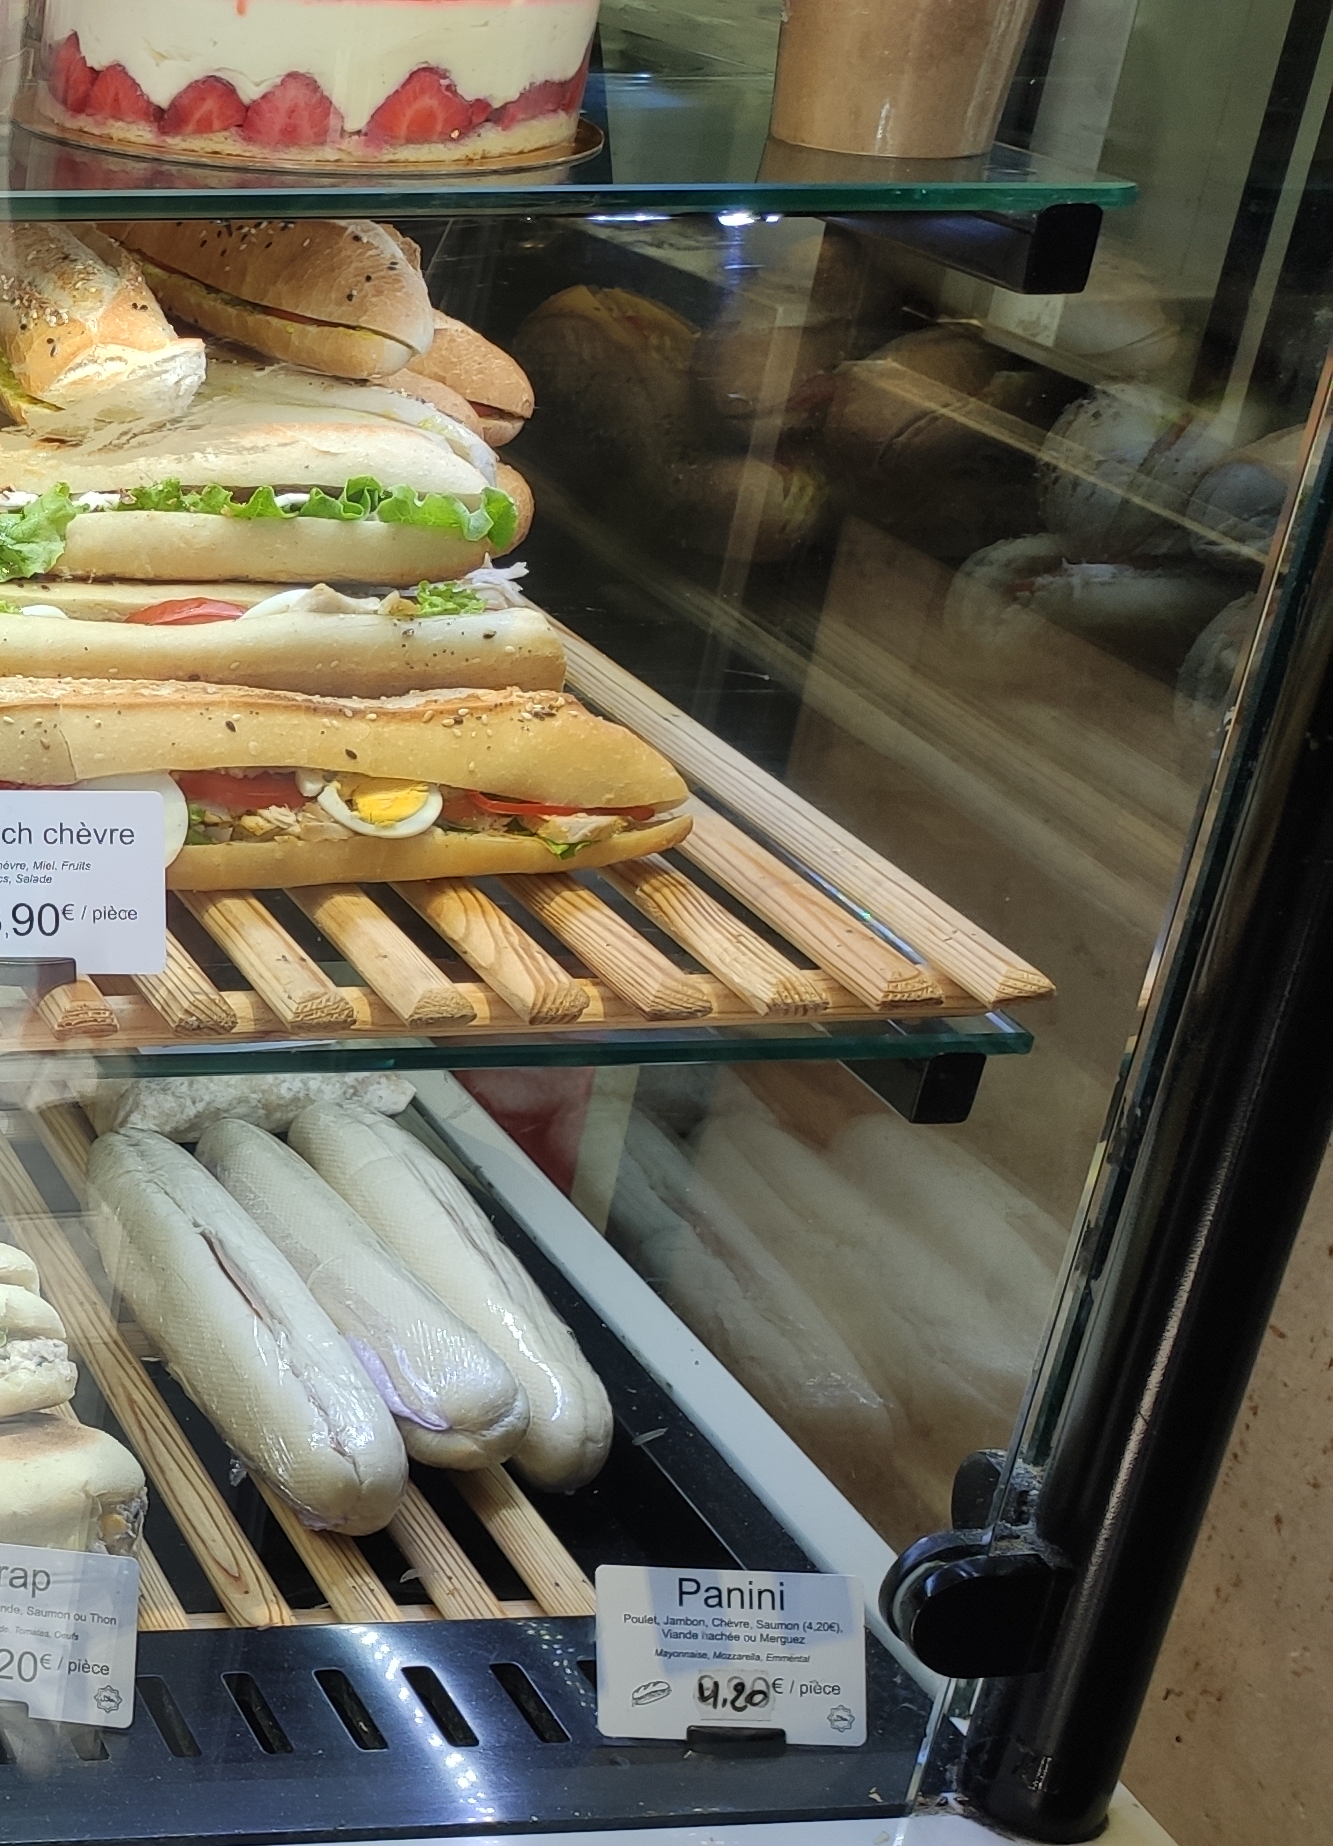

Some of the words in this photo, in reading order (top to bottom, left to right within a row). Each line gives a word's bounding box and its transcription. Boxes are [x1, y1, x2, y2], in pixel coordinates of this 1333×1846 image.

[44, 822, 134, 845] chèvre
[62, 861, 91, 870] Fruits
[16, 874, 52, 883] Salade
[81, 905, 87, 920] /
[93, 906, 137, 924] pièce
[679, 1578, 784, 1611] Panini
[27, 1606, 70, 1620] Saumon
[74, 1613, 86, 1621] ou
[90, 1613, 116, 1625] Thon
[624, 1614, 660, 1625] Poulet,
[663, 1616, 708, 1628] Jambon,
[712, 1618, 753, 1629] Chèvre,
[756, 1620, 799, 1630] Saumon
[16, 1626, 51, 1639] Tomates,
[662, 1629, 698, 1639] Viande
[702, 1631, 740, 1641] hachée
[760, 1633, 805, 1646] Merguez
[655, 1649, 710, 1660] Mayonnaise,
[713, 1651, 763, 1661] Mozzarella,
[766, 1653, 810, 1662] Emmental
[57, 1656, 63, 1670] /
[68, 1659, 109, 1675] pièce
[800, 1680, 841, 1697] pièce
